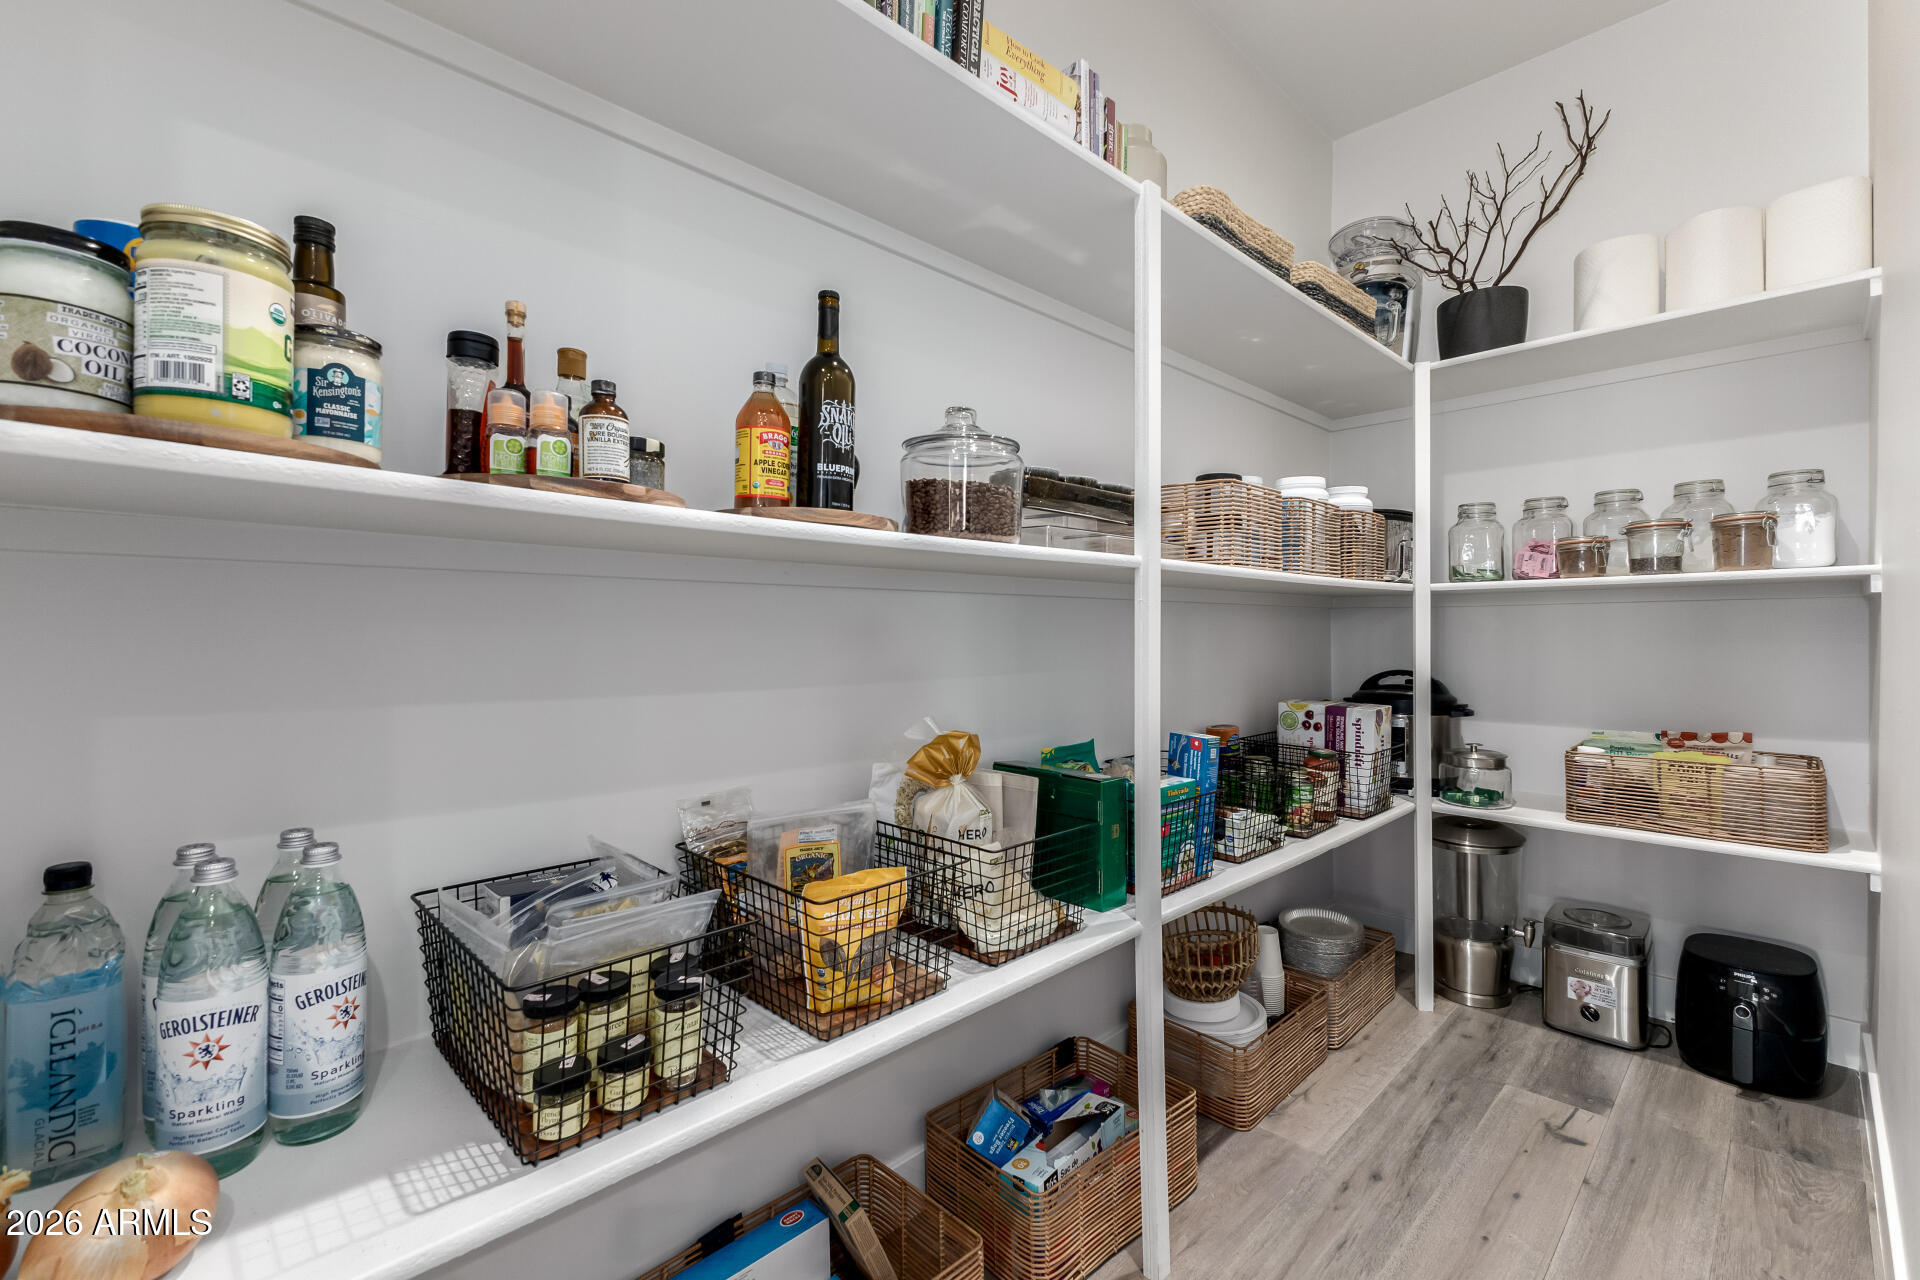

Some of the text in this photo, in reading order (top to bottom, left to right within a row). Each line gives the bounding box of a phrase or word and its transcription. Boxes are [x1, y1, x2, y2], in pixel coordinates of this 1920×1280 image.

[960, 2, 970, 58] COMFORT
[1005, 45, 1046, 84] Everything
[62, 305, 101, 321] TRADER
[49, 314, 112, 335] ORGANIC
[72, 329, 116, 345] VIRGIN
[84, 359, 122, 382] OIL
[315, 376, 329, 387] Sir
[312, 386, 362, 398] Kensington's
[316, 407, 358, 419] MAYONNAISE
[323, 402, 351, 412] CLASSIC
[762, 432, 787, 443] BRAGG
[753, 459, 775, 467] APPLE
[761, 466, 787, 476] VINEGAR
[1352, 717, 1365, 767] spindrift
[958, 826, 987, 841] HERO
[795, 852, 829, 862] ORGANIC
[1733, 971, 1756, 979] PHILIPS
[159, 1004, 260, 1040] GEROLSTEINER
[169, 1095, 246, 1121] Sparkling
[171, 1107, 243, 1127] Natural Mineral Water
[168, 1123, 246, 1147] Perfectly Balanced Taste
[172, 1120, 241, 1143] High Mineral Content
[988, 1115, 1016, 1155] Freezer Bags
[33, 1118, 45, 1167] GLACIAL
[1060, 1165, 1071, 1178] Sac
